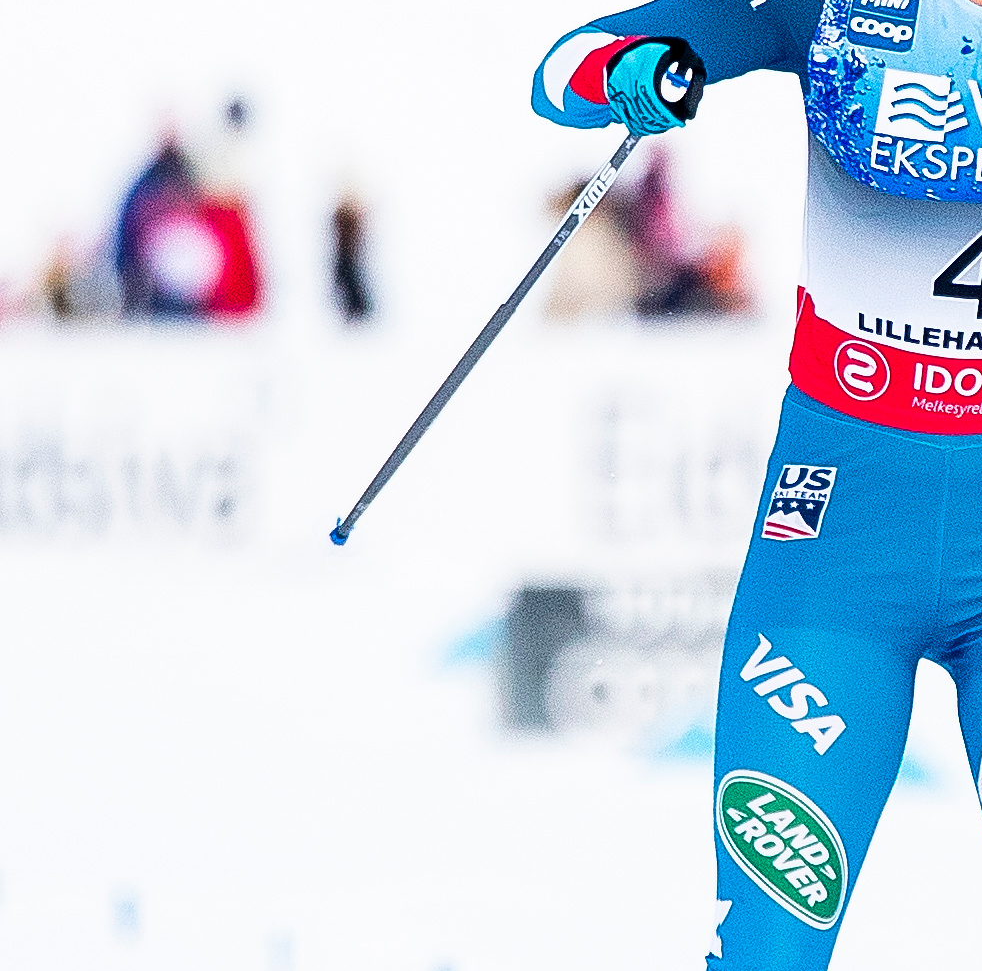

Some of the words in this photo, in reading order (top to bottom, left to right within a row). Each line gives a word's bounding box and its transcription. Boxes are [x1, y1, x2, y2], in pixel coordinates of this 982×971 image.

[850, 17, 913, 43] coop
[779, 467, 833, 491] US
[773, 490, 789, 499] SKI
[794, 490, 828, 500] TEAM
[739, 632, 848, 756] VISA
